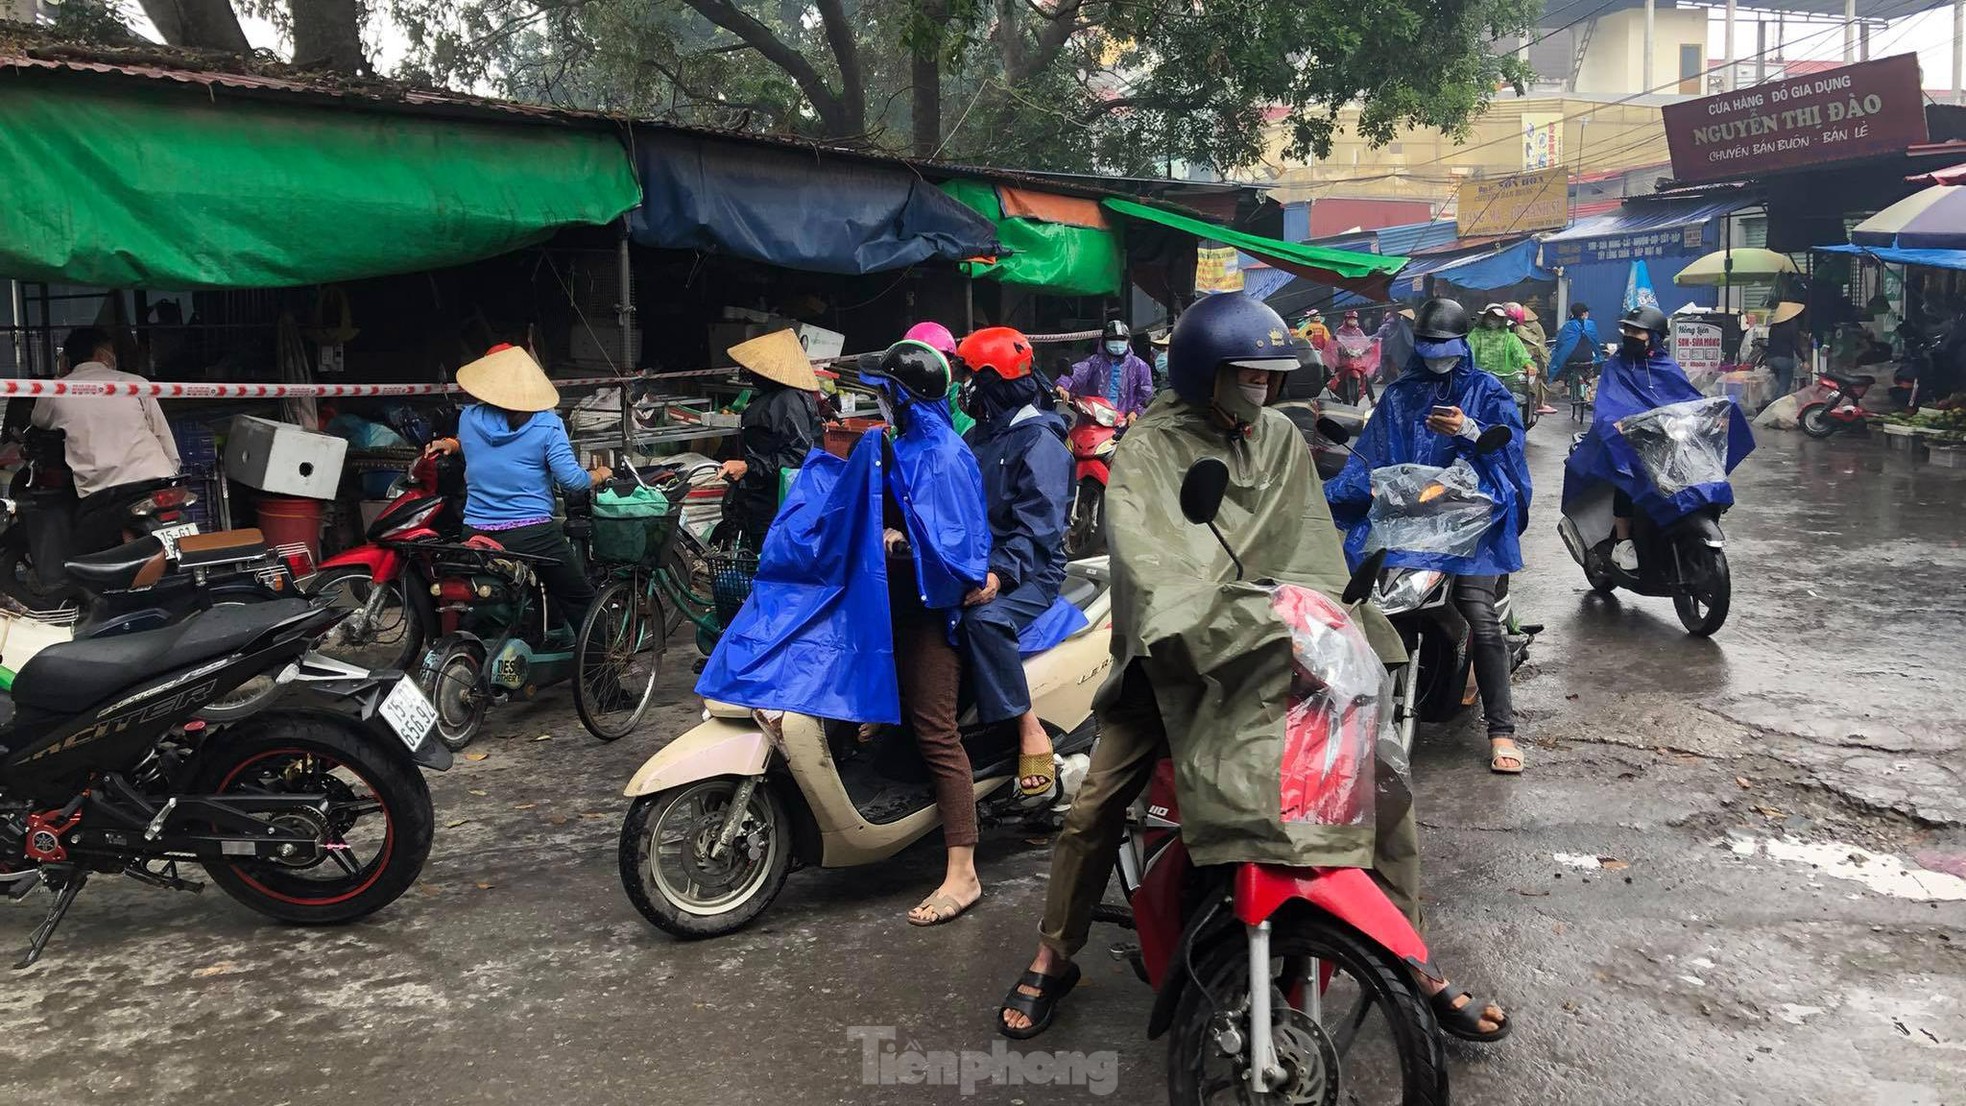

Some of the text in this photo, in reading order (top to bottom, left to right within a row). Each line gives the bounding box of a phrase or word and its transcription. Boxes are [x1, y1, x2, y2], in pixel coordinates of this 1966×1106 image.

[1708, 75, 1852, 115] CỬA HÀNG ĐỒ GIA DỤNG
[1693, 93, 1882, 146] NGUYỄN THỊ ĐÀO
[1709, 144, 1750, 162] CHUYÊN
[1753, 138, 1776, 155] BÁN
[1777, 134, 1810, 151] BUÔN
[1823, 125, 1848, 144] BÁN
[400, 700, 436, 747] 656.92
